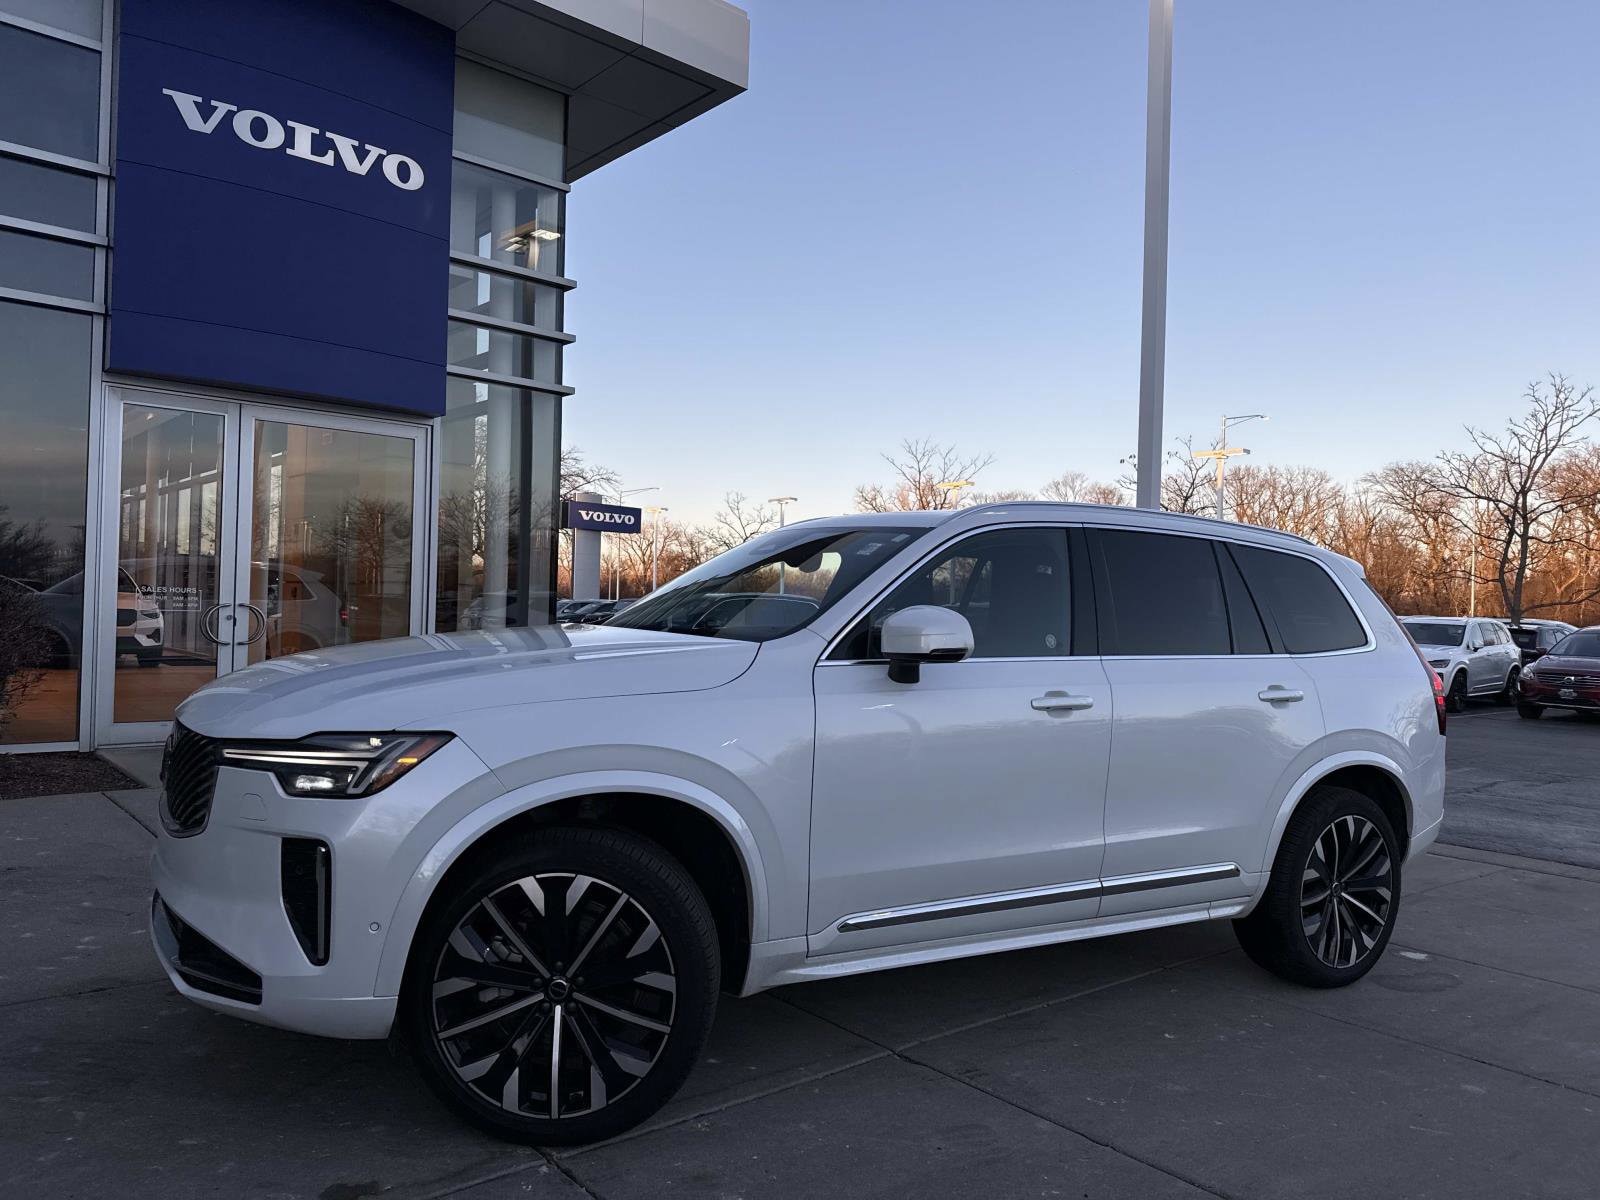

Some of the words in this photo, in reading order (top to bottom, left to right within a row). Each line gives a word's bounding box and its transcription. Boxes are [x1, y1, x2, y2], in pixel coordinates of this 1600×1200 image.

[162, 87, 425, 191] VOLVO
[578, 509, 635, 525] VOLVO
[141, 585, 168, 593] SALES
